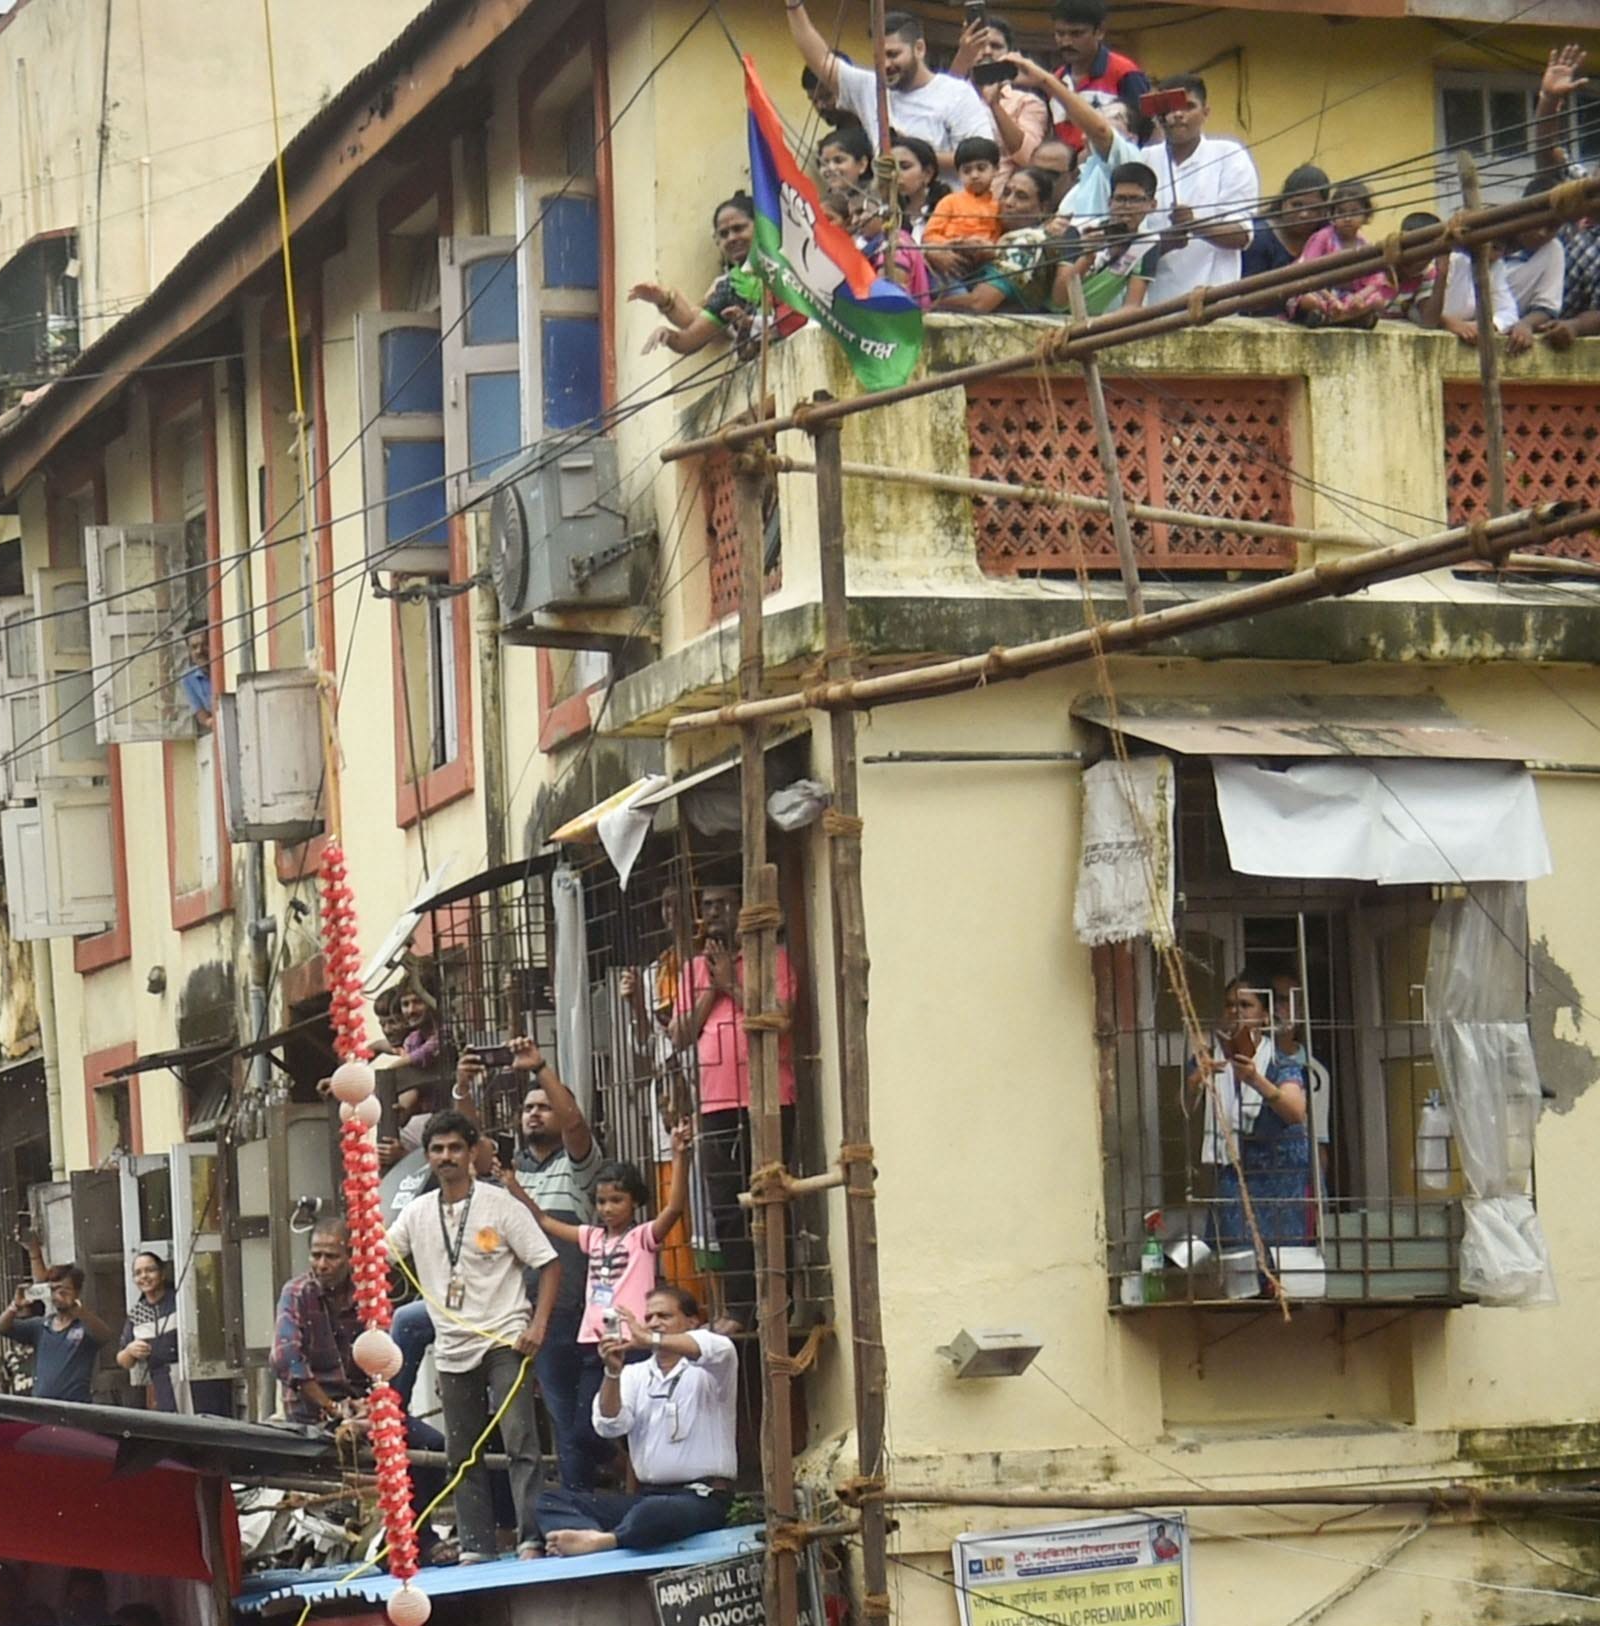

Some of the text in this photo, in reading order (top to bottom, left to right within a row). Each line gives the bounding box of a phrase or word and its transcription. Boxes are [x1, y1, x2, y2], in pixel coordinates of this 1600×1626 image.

[860, 339, 897, 360] पक्ष
[984, 1557, 1004, 1573] LIC
[1084, 1606, 1136, 1625] PREMIUM
